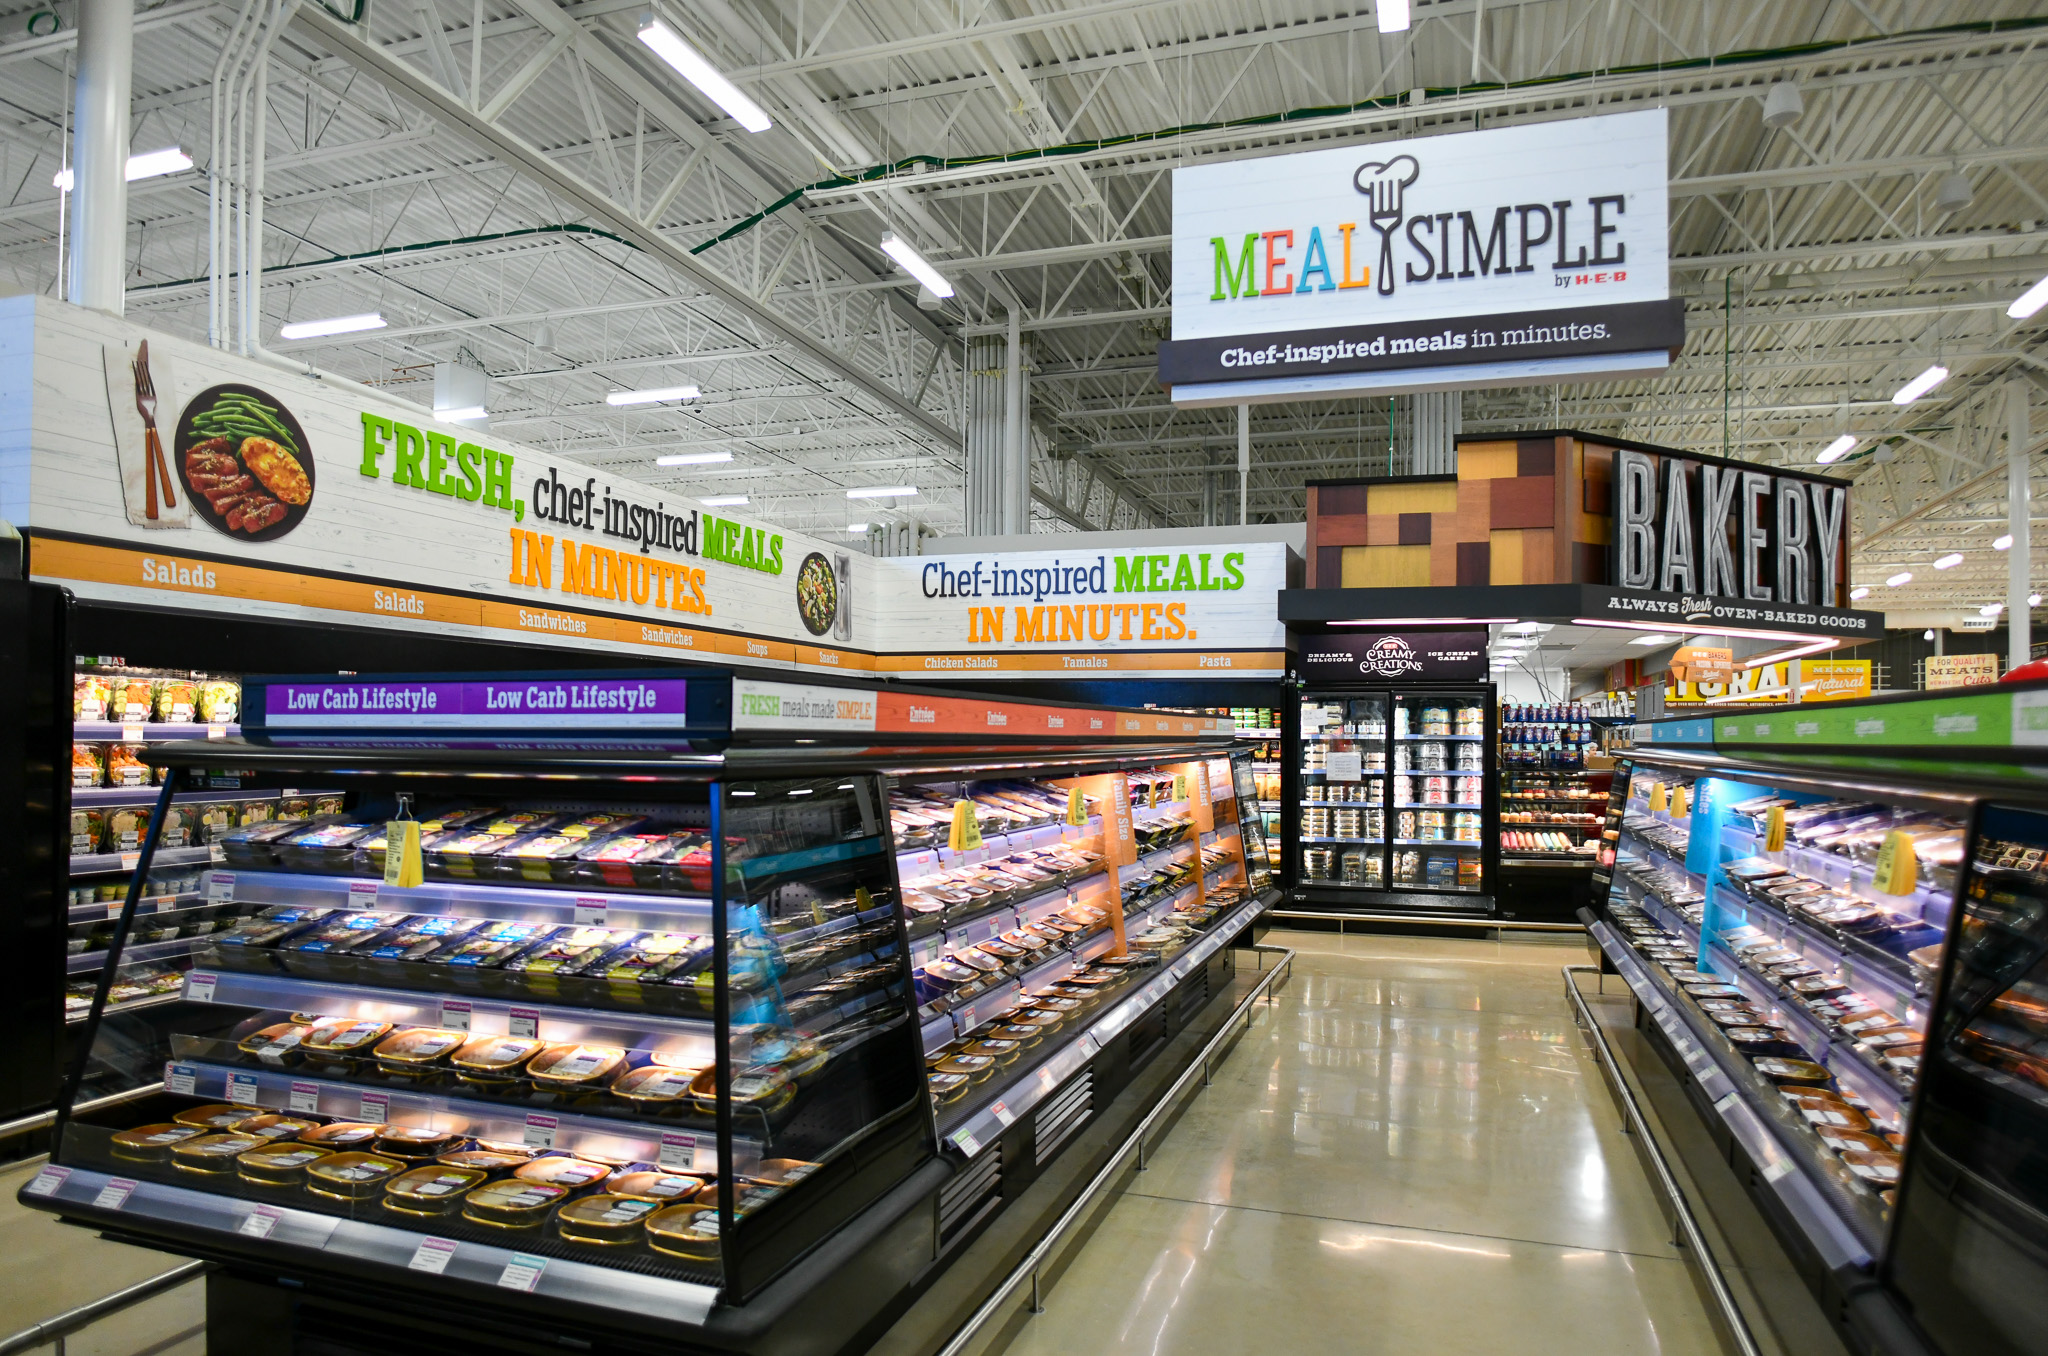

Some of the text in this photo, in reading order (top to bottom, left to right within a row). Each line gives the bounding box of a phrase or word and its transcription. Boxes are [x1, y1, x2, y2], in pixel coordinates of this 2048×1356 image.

[1210, 194, 1626, 301] MEAL SIMPLE
[1554, 275, 1571, 288] by
[1220, 322, 1612, 367] Chef-inspired meals in minutes.
[360, 410, 784, 576] FRESH, chef-inspired MEALS
[1614, 449, 1846, 608] BAKERY
[142, 557, 217, 590] Salads
[510, 527, 712, 617] IN MINUTES.
[922, 552, 1245, 602] Chef-inspired MEALS
[373, 589, 425, 615] Salads
[1607, 597, 1679, 614] ALWAYS
[1681, 596, 1713, 615] Fresh
[1819, 615, 1867, 629] GOODS
[519, 608, 588, 634] Sandwiches
[967, 602, 1197, 643] IN MINUTES.
[641, 625, 694, 646] Sandwiches
[746, 640, 769, 657] Soups
[819, 651, 839, 665] Snacks
[1366, 649, 1416, 661] CREAMY
[112, 657, 126, 666] A3
[924, 656, 998, 669] Chicken Salads
[1062, 656, 1108, 669] Tamales
[1200, 655, 1232, 668] Pasta
[1360, 660, 1423, 673] CREATIONS
[1812, 666, 1864, 674] MEANS
[1930, 666, 1993, 675] MEATS
[1937, 657, 1986, 667] FOR QUALITY
[1812, 675, 1865, 693] Natural
[1963, 675, 1992, 687] Cuts
[288, 687, 438, 712] Low Carb Lifestyle
[486, 684, 657, 712] Low Carb Lifestyle
[741, 693, 781, 716] FRESH
[782, 697, 810, 718] meals
[811, 699, 835, 719] made
[1197, 766, 1209, 807] Breakfast
[1113, 779, 1129, 841] Family Size
[1698, 784, 1713, 815] Sides
